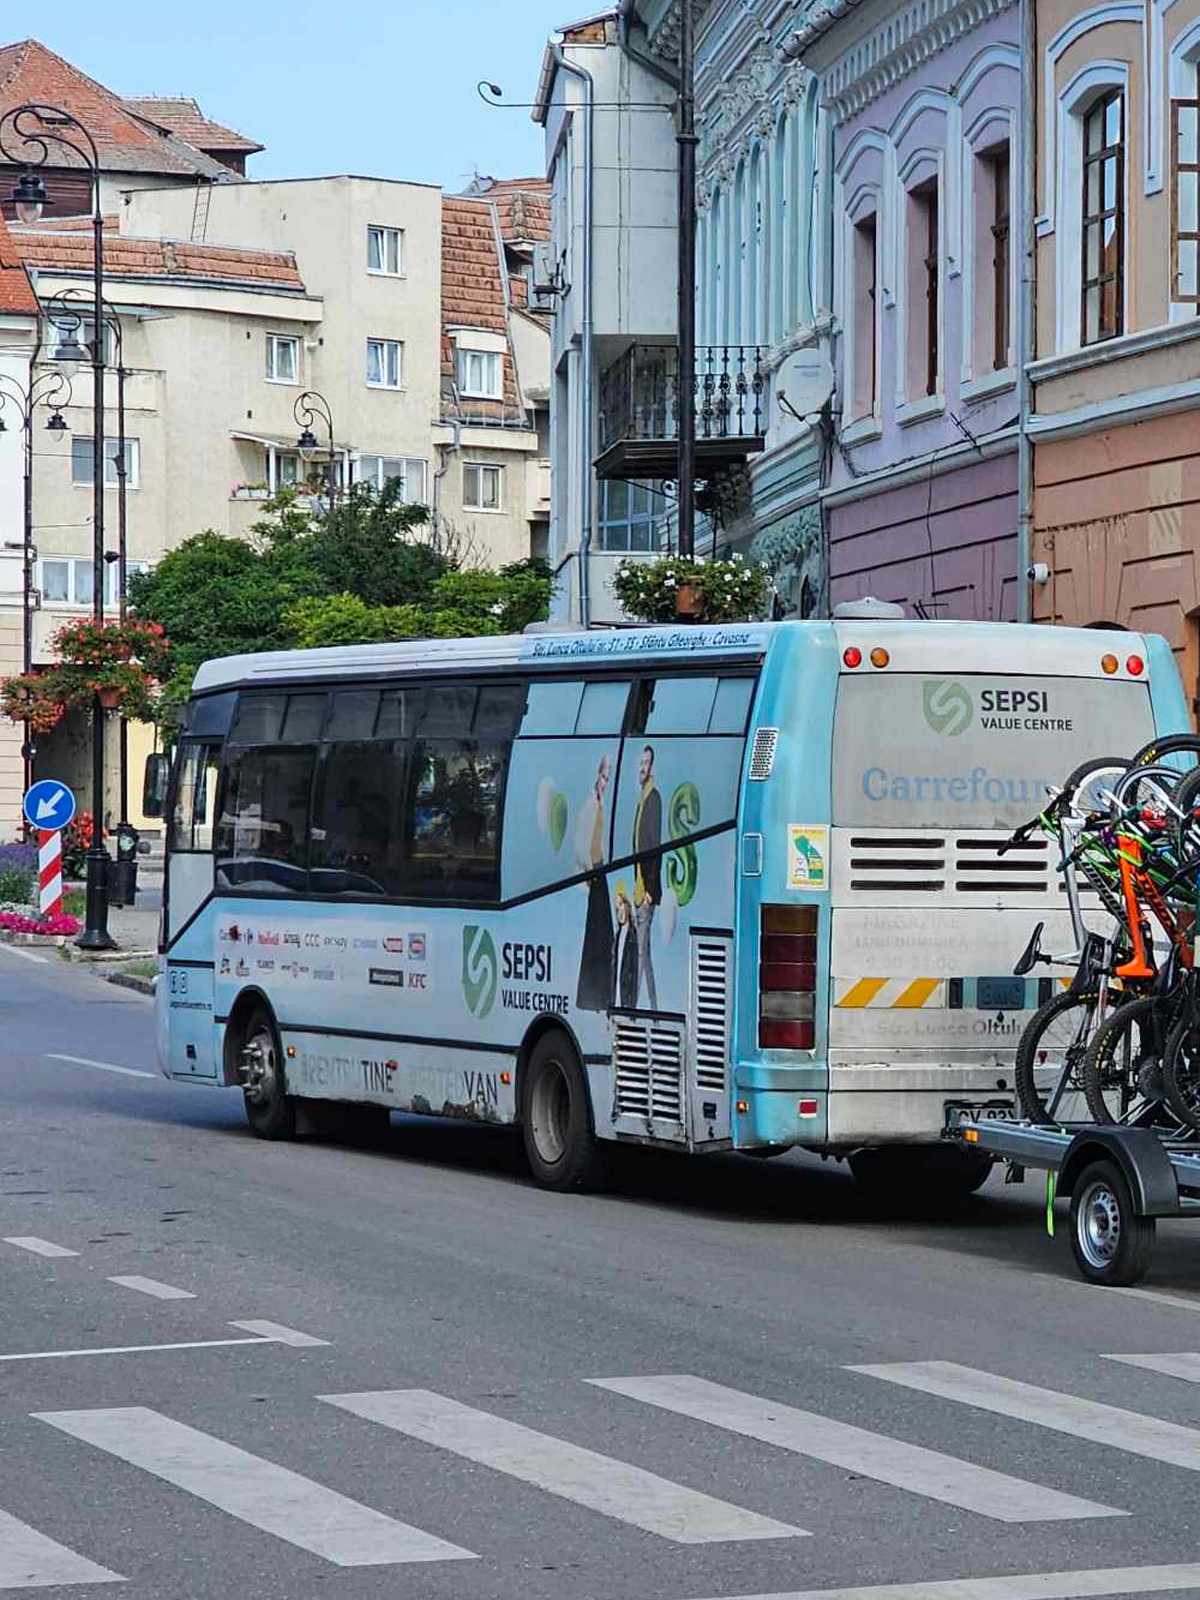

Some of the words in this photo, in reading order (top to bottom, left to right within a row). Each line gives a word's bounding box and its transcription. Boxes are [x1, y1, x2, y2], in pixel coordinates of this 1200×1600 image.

[668, 631, 706, 650] Gheorghe
[713, 631, 750, 645] Covasna
[981, 690, 1047, 712] SEPSI
[981, 718, 1021, 731] VALUE
[1024, 718, 1073, 731] CENTRE
[863, 767, 1052, 803] Carrefour
[502, 942, 552, 982] SEPSI
[408, 972, 427, 989] KFC
[502, 989, 531, 1011] VALUE
[532, 992, 569, 1015] CENTRE
[361, 1060, 394, 1093] TINE
[463, 1069, 498, 1106] VAN
